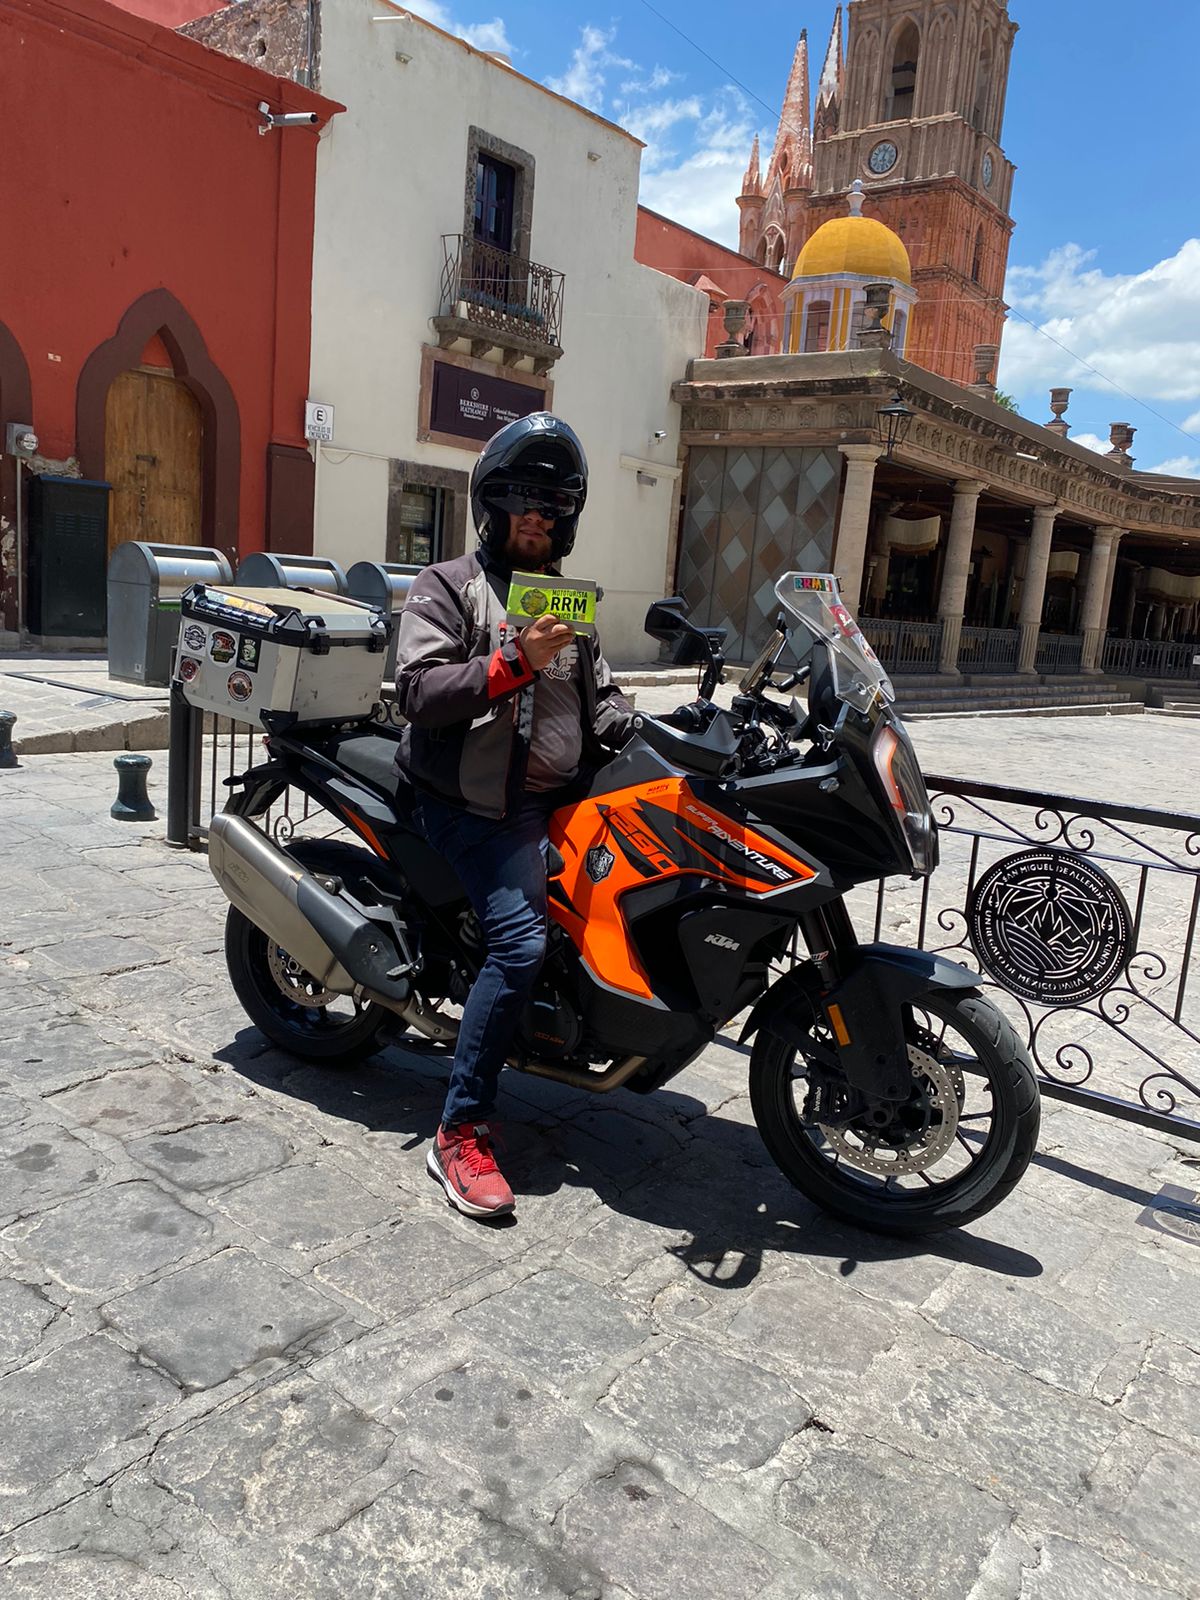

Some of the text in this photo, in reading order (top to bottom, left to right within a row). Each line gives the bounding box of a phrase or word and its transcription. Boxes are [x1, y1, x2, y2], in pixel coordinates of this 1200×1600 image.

[459, 399, 489, 411] BERKSHIRE
[316, 409, 324, 422] E
[552, 589, 588, 599] MOTOTURISTA
[550, 596, 588, 614] RRM
[685, 804, 719, 827] SUPER
[708, 825, 793, 881] ADVENTURE
[1002, 863, 1107, 902] SAN MIGUEL DE ALLENDE
[984, 910, 993, 925] UN
[704, 933, 741, 951] KTM
[985, 926, 1006, 964] REGALO
[1093, 935, 1116, 972] MUNDO
[1058, 978, 1085, 991] PARA
[1083, 971, 1096, 982] EL
[813, 1086, 822, 1112] brembo
